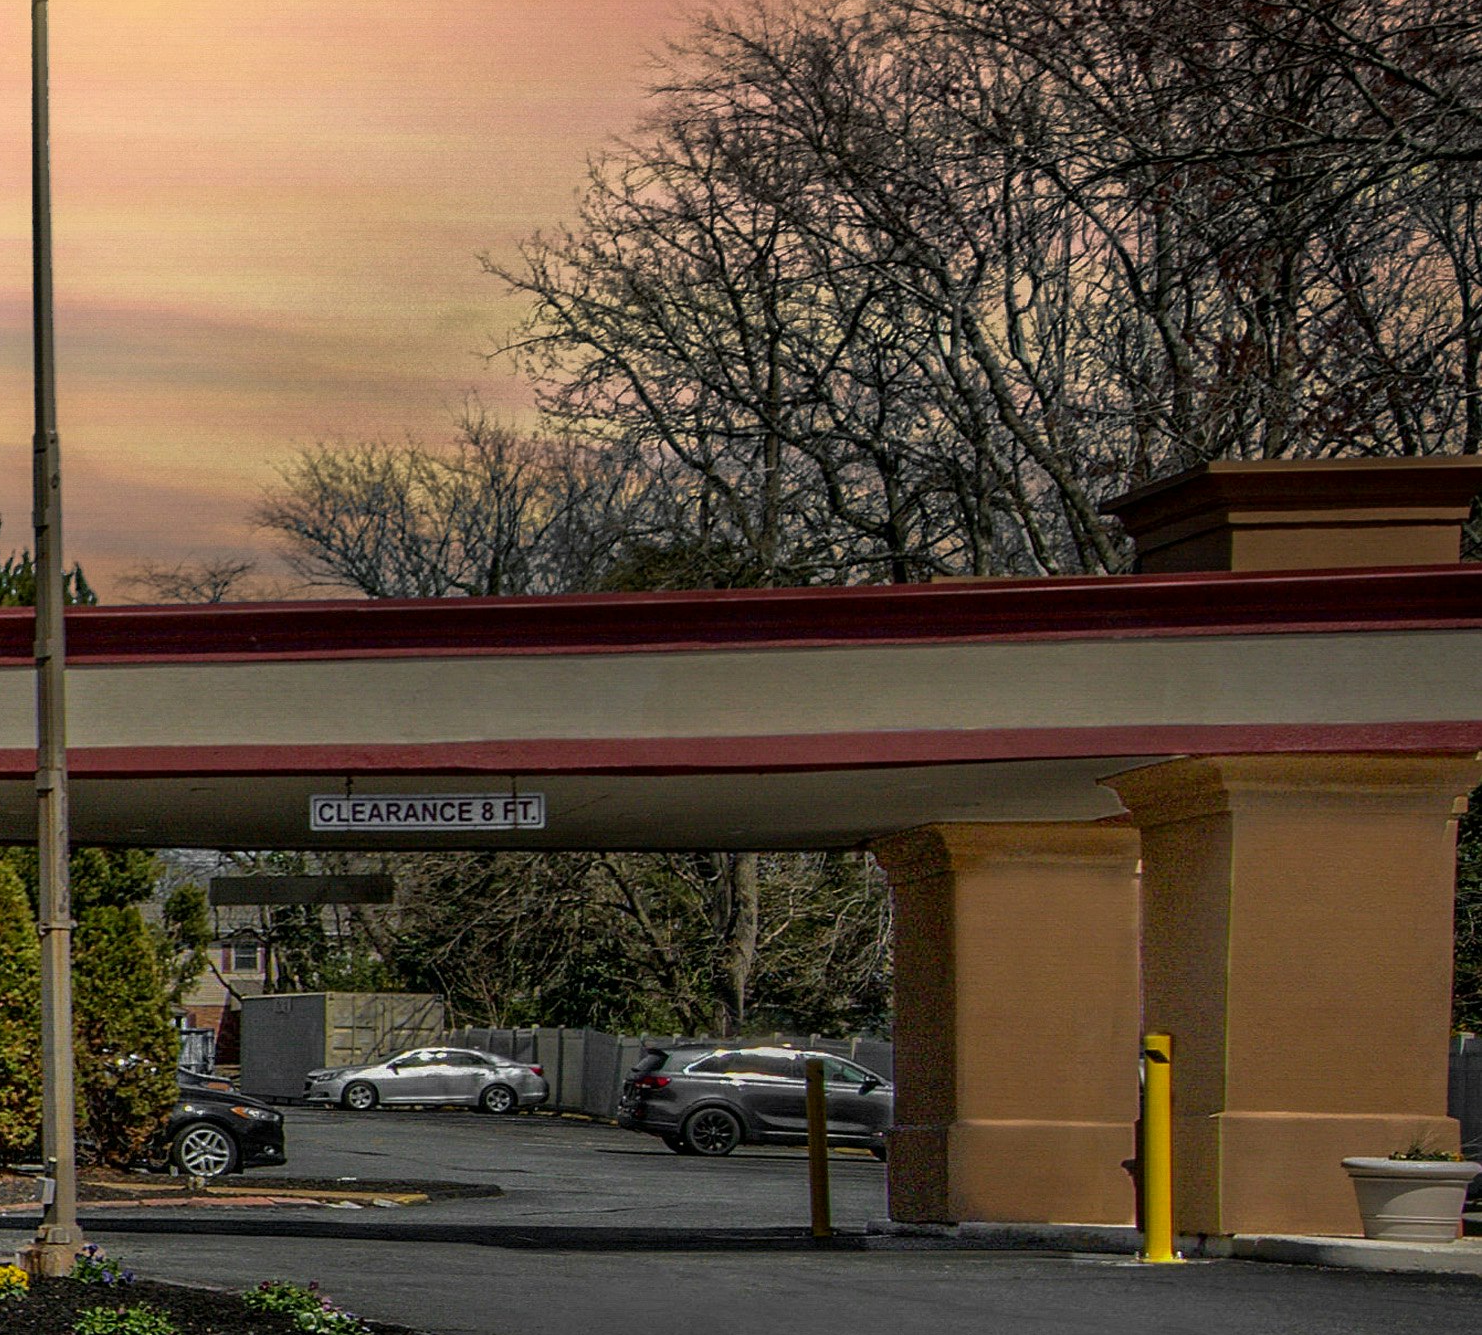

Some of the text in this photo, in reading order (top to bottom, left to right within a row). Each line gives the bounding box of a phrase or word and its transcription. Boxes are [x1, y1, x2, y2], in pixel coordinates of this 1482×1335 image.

[317, 799, 537, 824] CLEARANCE 8 FT.
